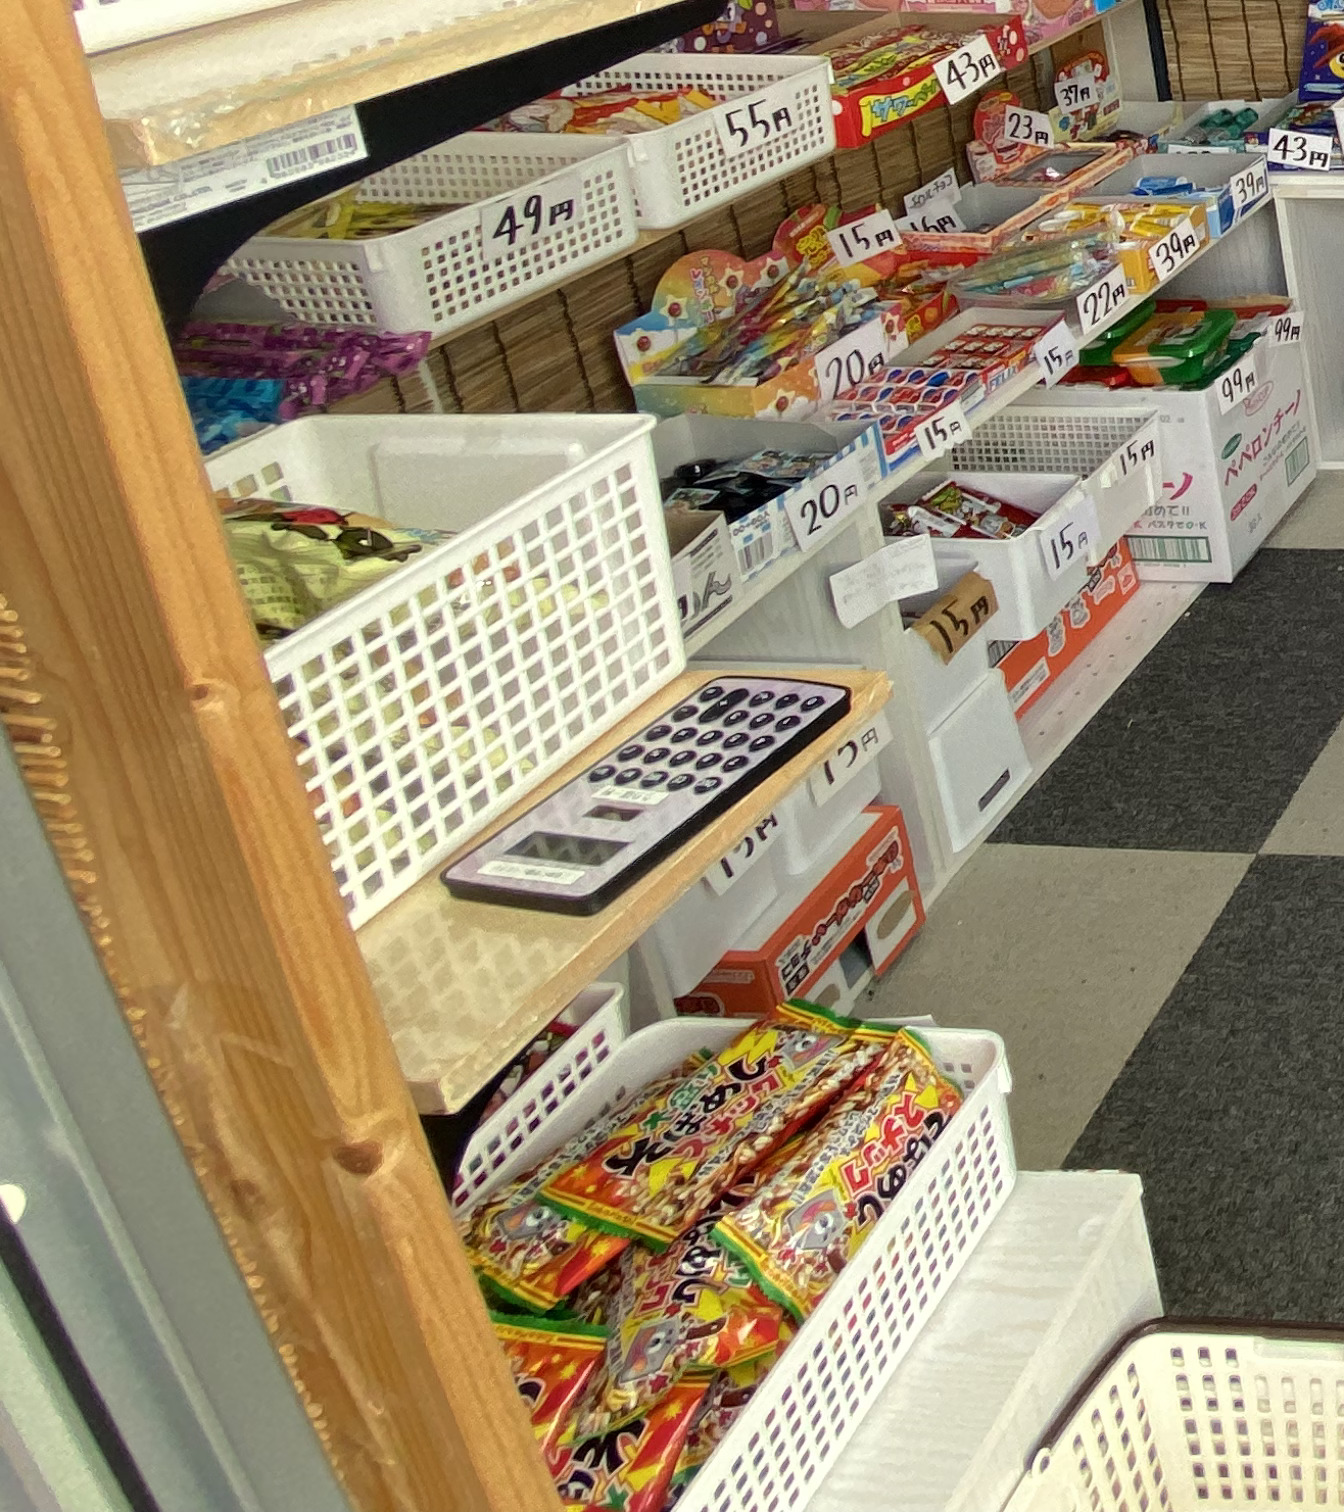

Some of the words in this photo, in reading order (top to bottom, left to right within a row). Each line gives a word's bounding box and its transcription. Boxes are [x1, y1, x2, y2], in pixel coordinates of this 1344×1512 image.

[945, 52, 997, 91] 43円
[726, 98, 792, 147] 55円
[1008, 112, 1049, 145] 23円
[1272, 134, 1327, 167] 43円
[1235, 172, 1265, 205] 39円
[493, 194, 574, 246] 49円
[838, 223, 895, 258] 15円
[1155, 232, 1197, 273] 39円
[1083, 281, 1126, 326] 22円
[1221, 367, 1255, 403] 99円
[924, 418, 963, 449] 15円
[1120, 440, 1156, 475] 15円
[800, 484, 859, 536] 20円
[1050, 522, 1089, 570] 15円
[928, 593, 991, 652] 15円
[604, 1058, 768, 1177] そばめし
[675, 1069, 783, 1160] スナック
